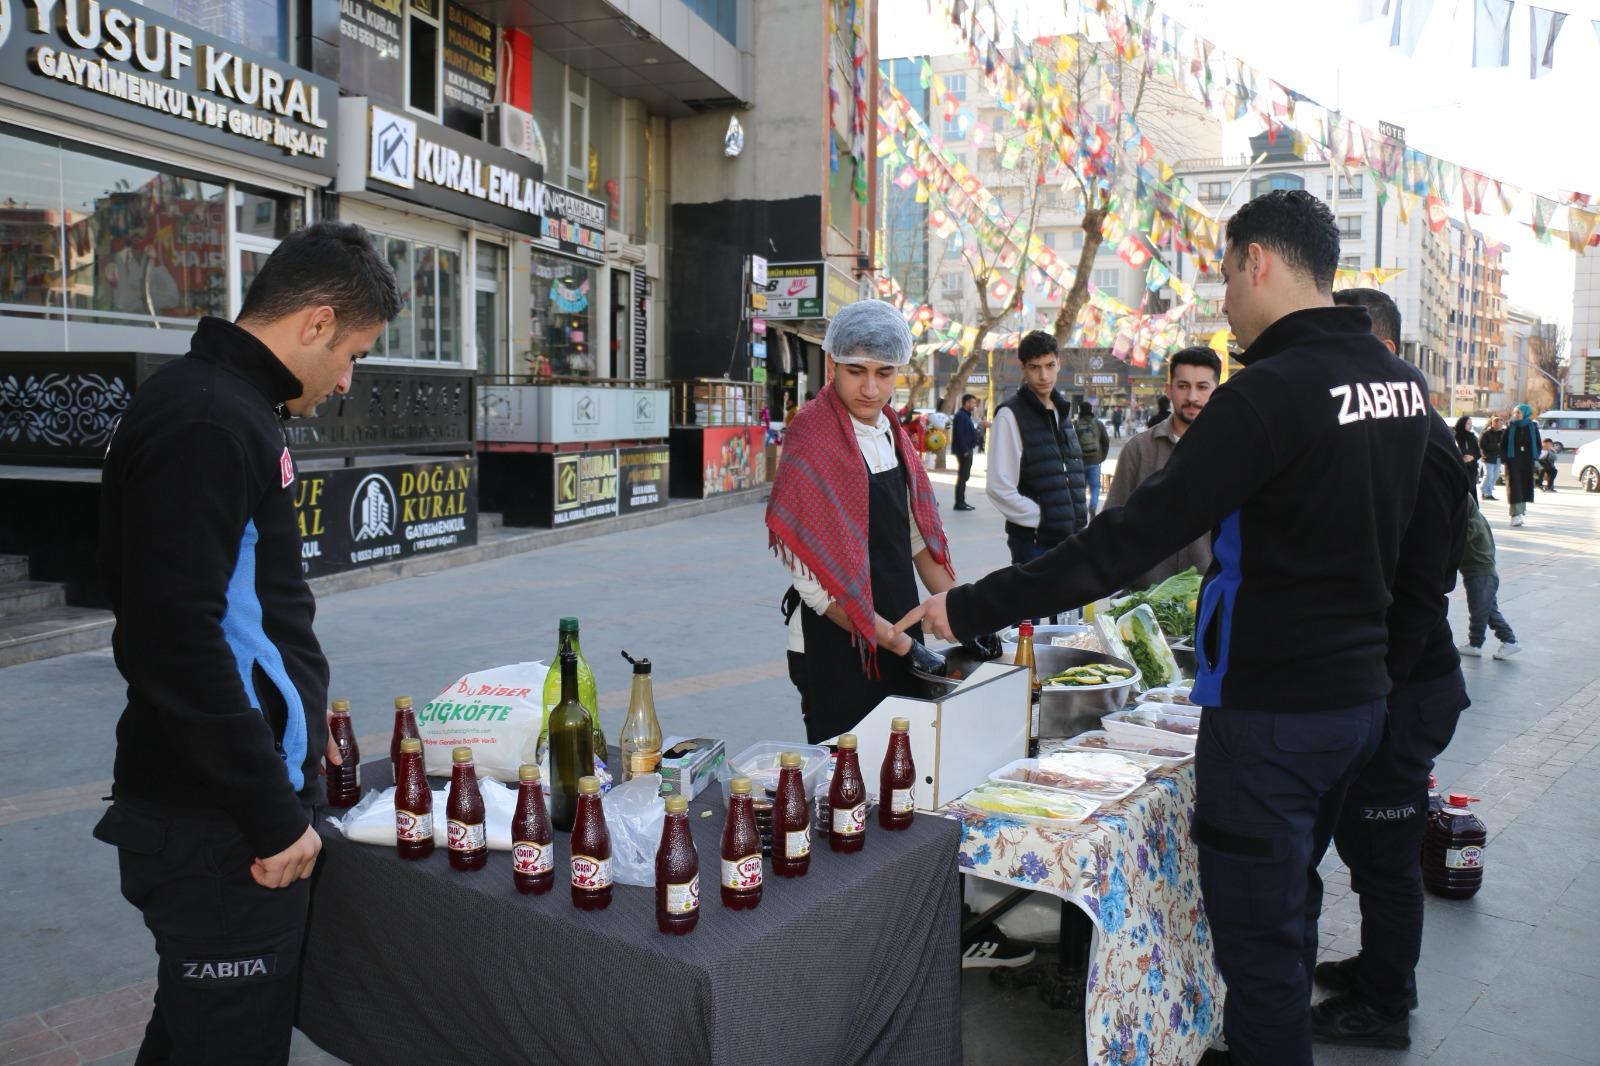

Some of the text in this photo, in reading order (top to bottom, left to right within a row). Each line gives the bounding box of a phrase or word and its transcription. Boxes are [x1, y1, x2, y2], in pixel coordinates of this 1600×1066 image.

[366, 10, 400, 40] KURAL
[33, 0, 328, 128] YUSUF KURAL
[36, 46, 192, 119] GAYRİMENKUL
[228, 109, 273, 142] GRUP
[273, 117, 328, 158] İNŞAAT
[416, 138, 487, 200] KURAL
[488, 164, 546, 217] EMLAK
[1329, 381, 1427, 425] ZABITA
[400, 466, 471, 497] DOĞAN
[402, 492, 468, 523] KURAL
[405, 517, 466, 540] GAYRİMENKUL
[417, 700, 512, 727] ÇİĞKÖFTE
[1364, 806, 1417, 820] ZABITA
[183, 958, 269, 980] ZABITA
